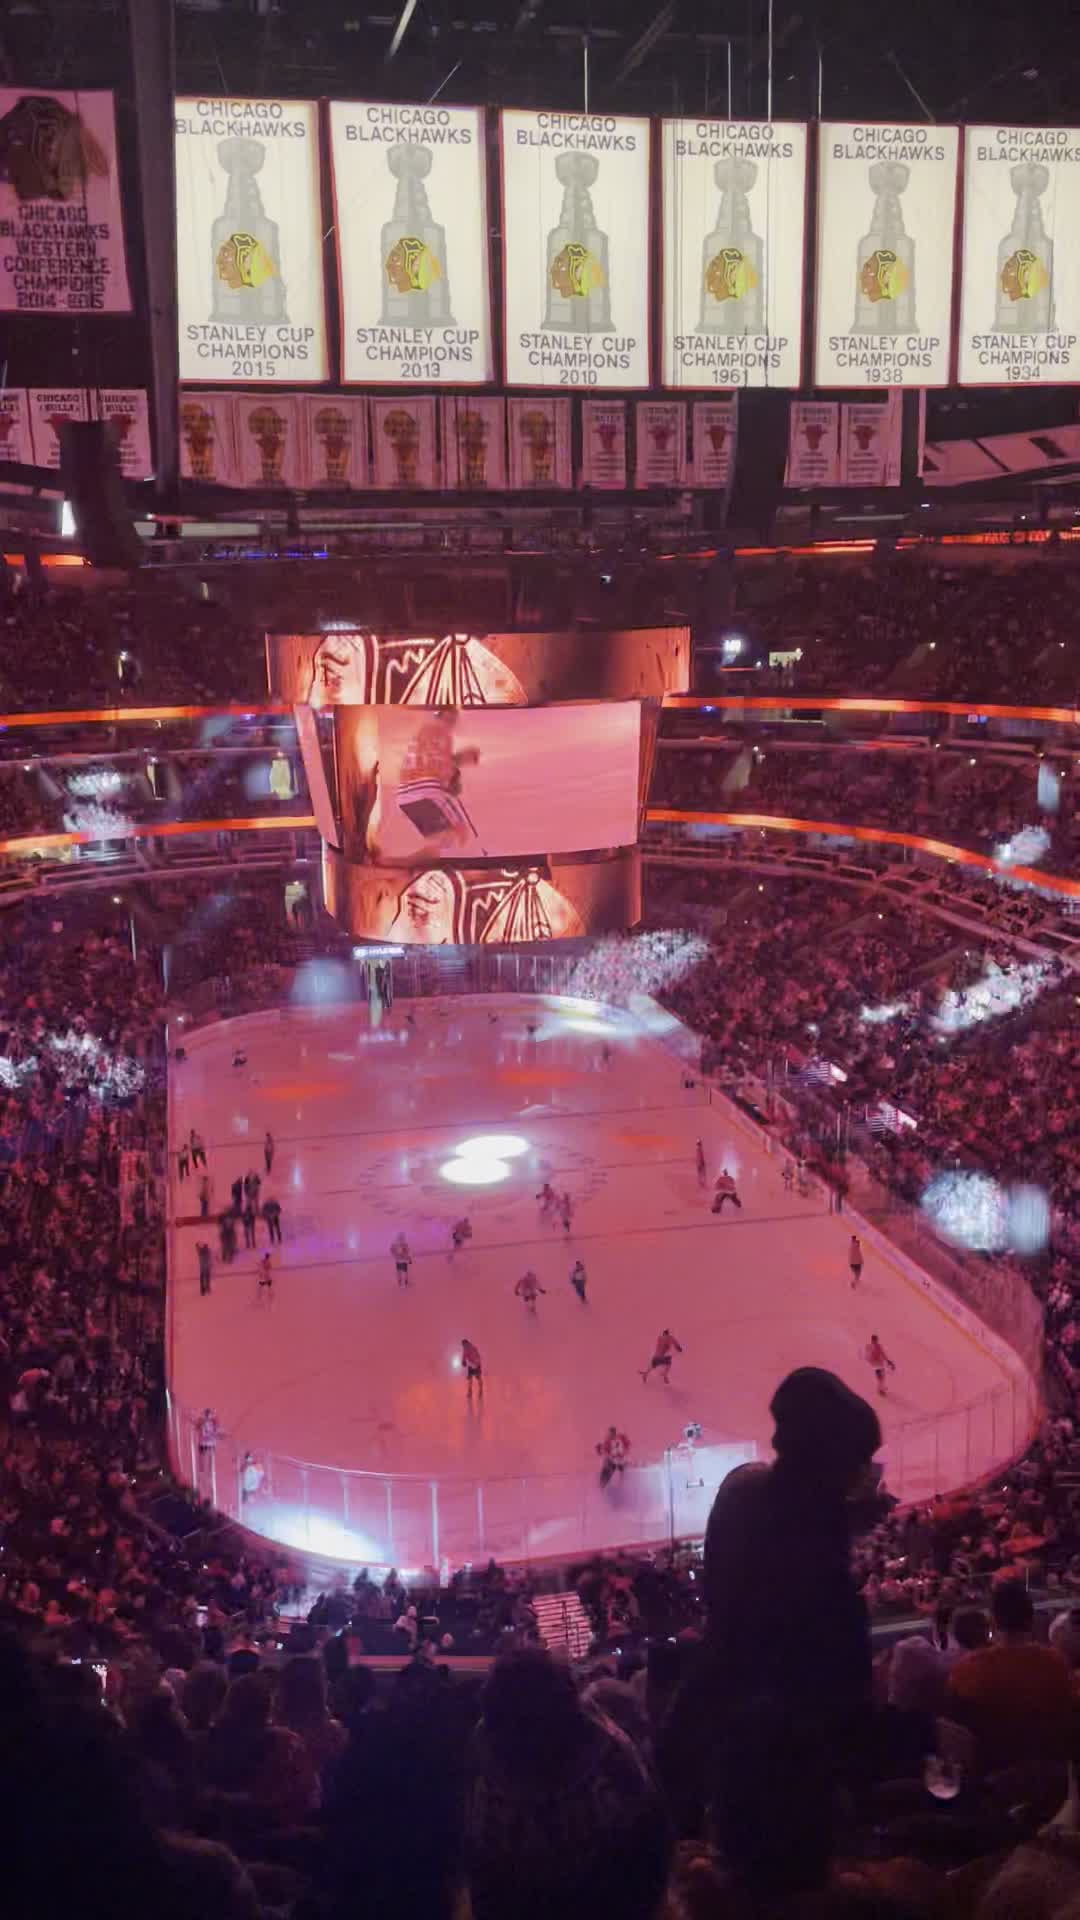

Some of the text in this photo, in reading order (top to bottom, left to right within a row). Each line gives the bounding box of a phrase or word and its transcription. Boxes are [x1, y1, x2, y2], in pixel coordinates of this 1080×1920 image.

[196, 100, 283, 119] CHICAGO
[366, 107, 450, 126] CHICAGO
[175, 119, 306, 137] BLACKHAWKS
[537, 113, 617, 132] CHICAGO
[345, 125, 472, 144] BLACKHAWKS
[516, 129, 637, 151] BLACKHAWKS
[696, 123, 774, 140] CHICAGO
[852, 127, 928, 143] CHICAGO
[996, 129, 1068, 145] CHICAGO
[675, 140, 793, 158] BLACKHAWKS
[833, 144, 945, 161] BLACKHAWKS
[976, 146, 1080, 162] BLACKHAWKS
[19, 206, 88, 222] CHICAGO
[0, 220, 110, 240] BLACKHAWKS
[16, 240, 97, 257] WESTERN
[4, 256, 112, 275] CONFERENCE
[14, 274, 106, 292] CHAMPIONS
[186, 325, 315, 342] STANLEY CUP
[356, 328, 480, 344] STANLEY CUP
[971, 335, 1077, 349] STANLEY CUP
[519, 333, 637, 352] STANLEY CUP
[673, 336, 788, 352] STANLEY CUP
[829, 336, 940, 352] STANLEY CUP
[197, 343, 309, 360] CHAMPIONS
[366, 346, 473, 361] CHAMPIONS
[528, 351, 631, 368] CHAMPIONS
[682, 352, 781, 368] CHAMPIONS
[836, 352, 932, 367] CHAMPIONS
[978, 351, 1071, 365] CHAMPIONS
[232, 361, 276, 376] 2015
[400, 362, 441, 378] 2013
[712, 369, 748, 384] 1961
[865, 368, 903, 383] 1938
[1005, 365, 1041, 381] 1934
[560, 369, 598, 386] 2010
